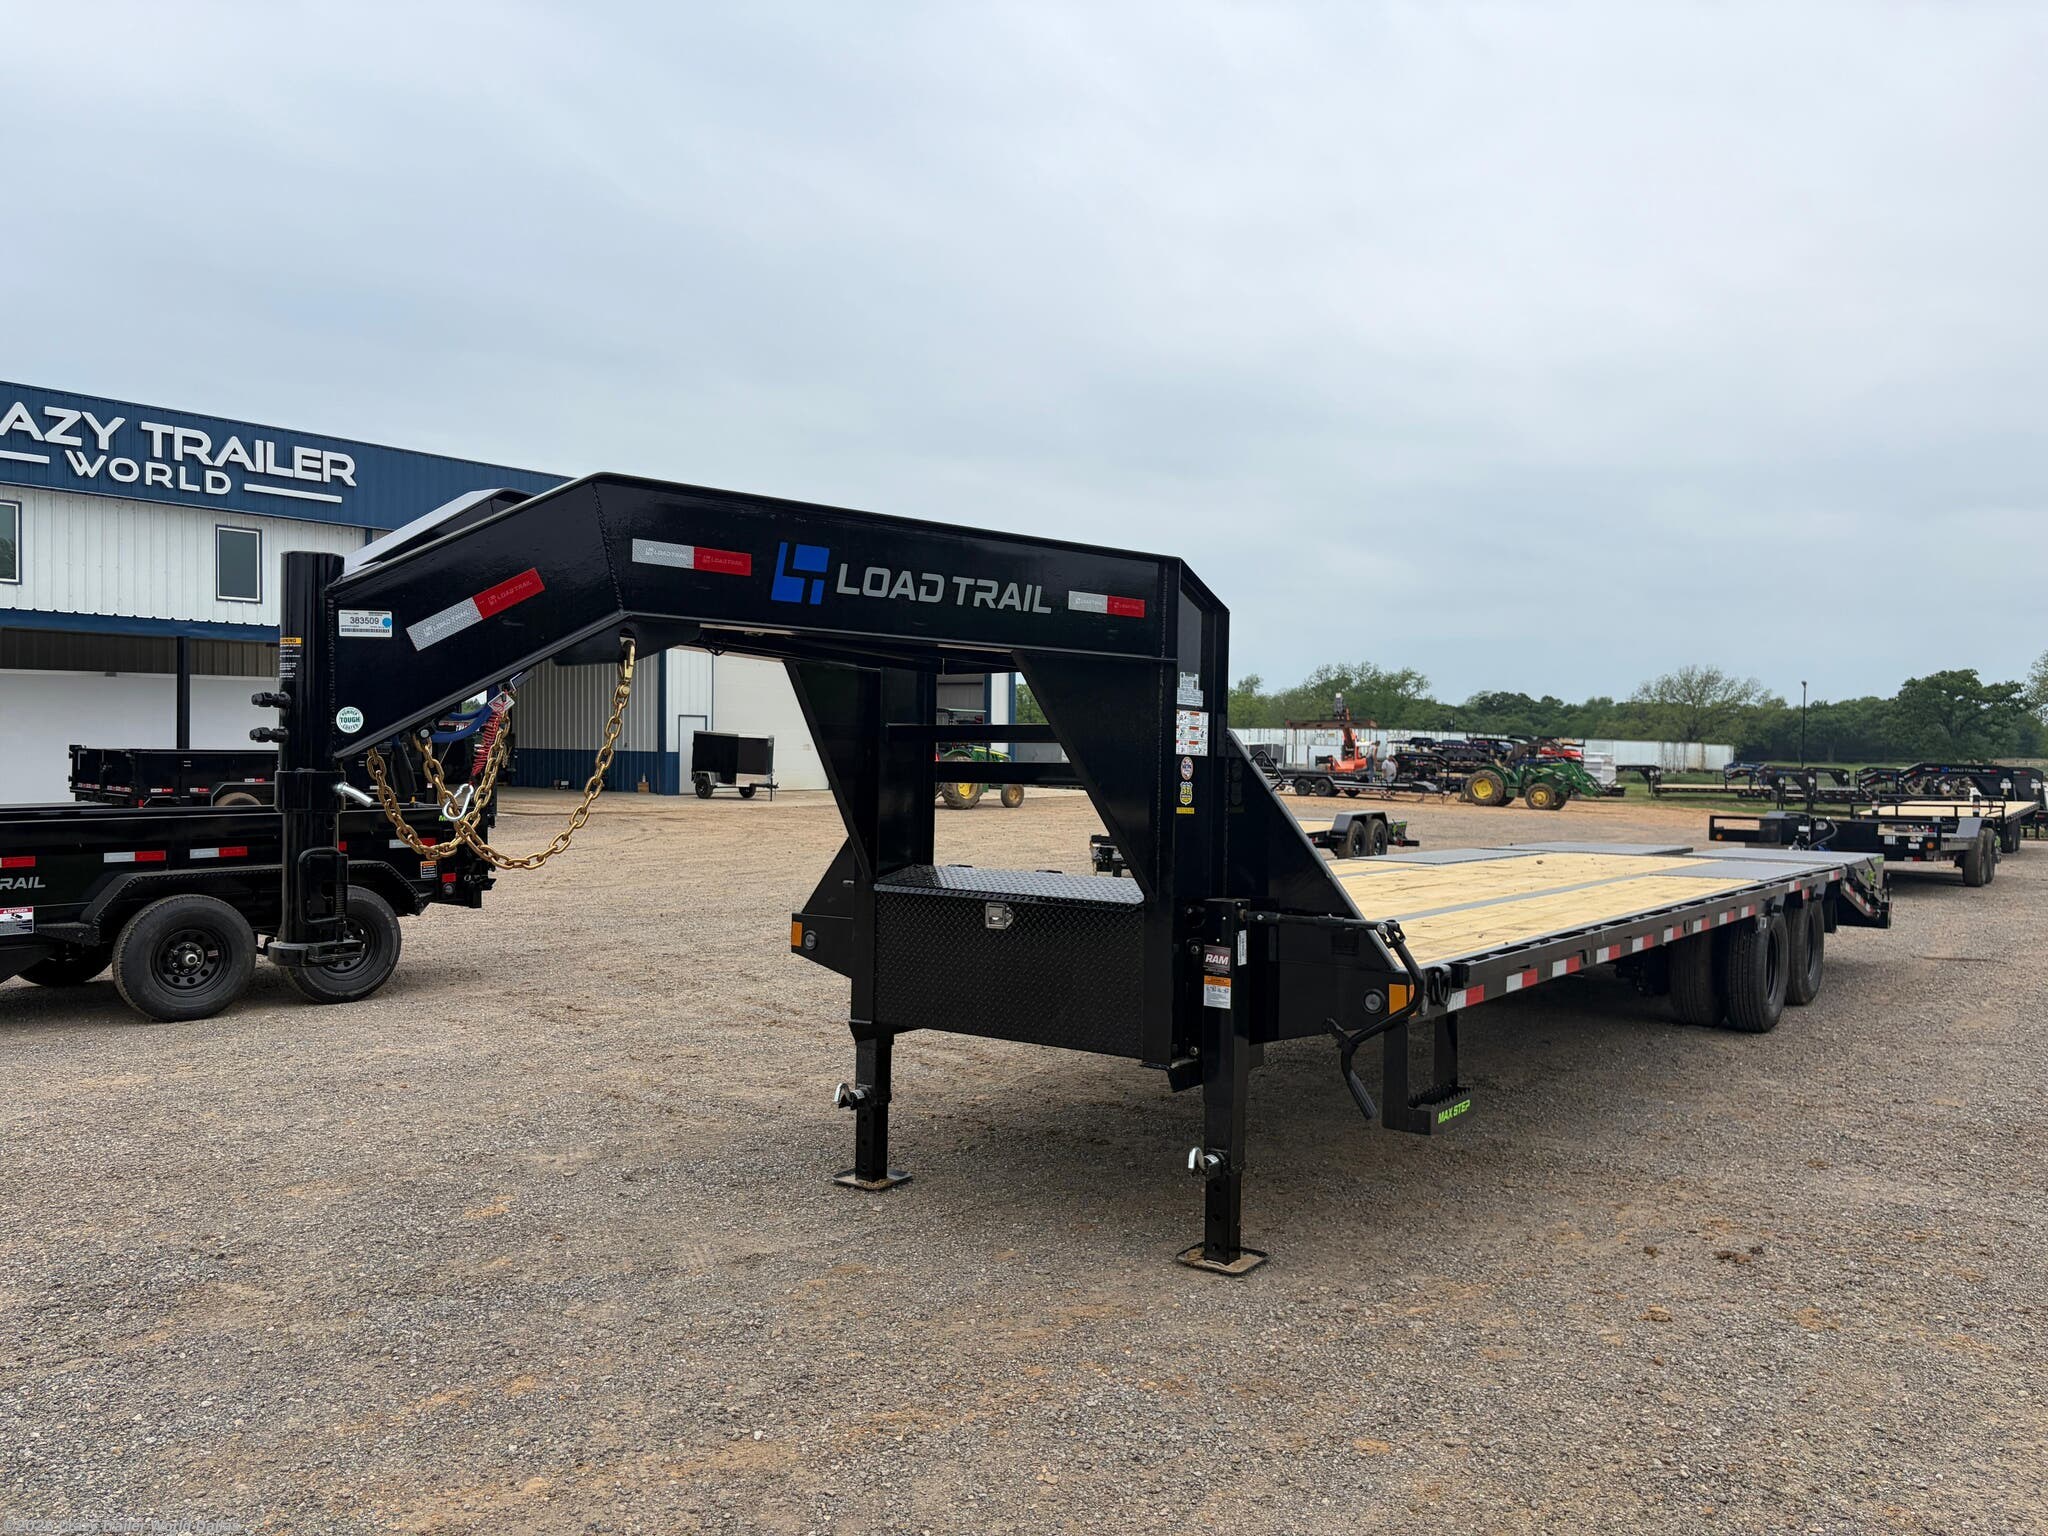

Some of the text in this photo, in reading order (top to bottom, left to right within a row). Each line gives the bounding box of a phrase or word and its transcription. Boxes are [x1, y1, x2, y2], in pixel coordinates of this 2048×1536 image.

[0, 401, 358, 487] AZY TRAILER
[64, 449, 232, 495] WORLD
[836, 563, 945, 603] LOAD
[950, 575, 1052, 614] TRAIL
[350, 616, 380, 625] 383509
[1205, 953, 1230, 966] RAM
[1438, 1099, 1471, 1124] MAX STEP
